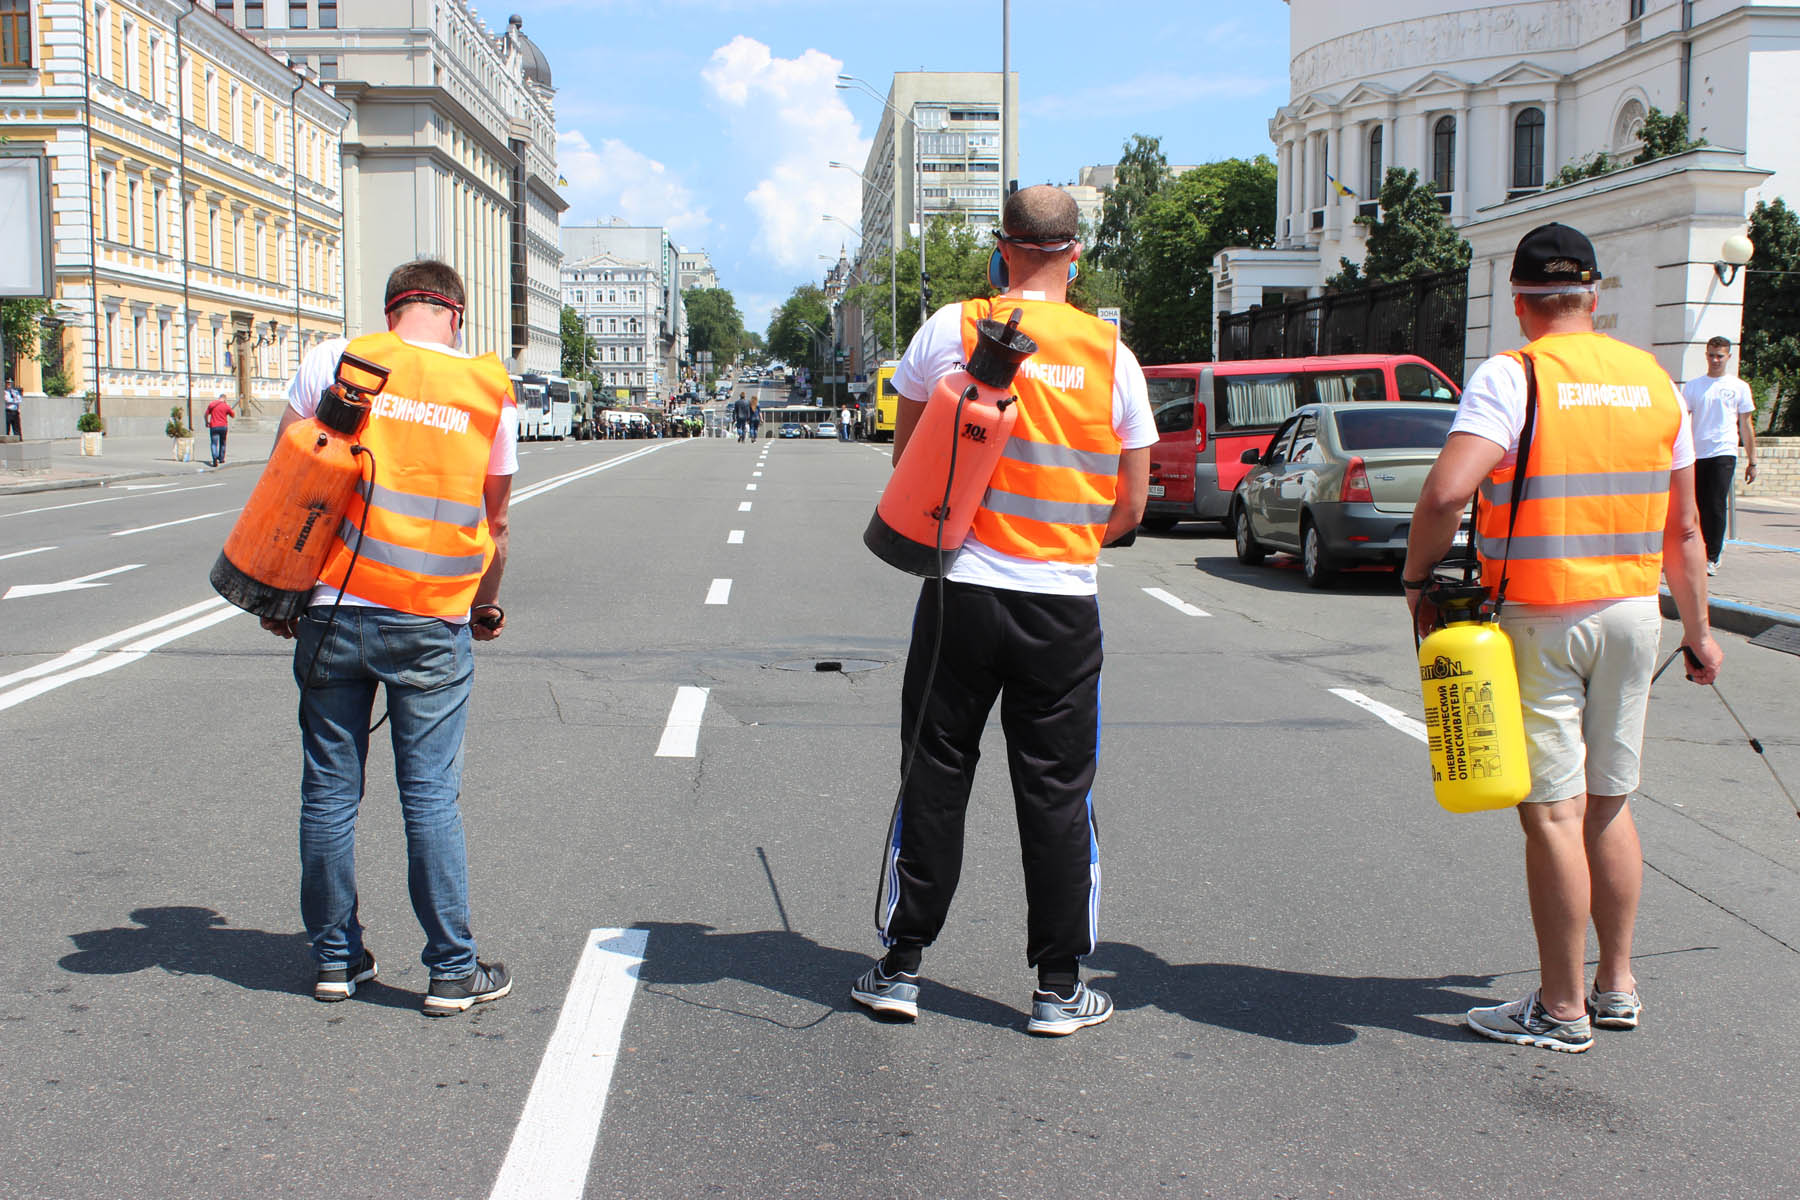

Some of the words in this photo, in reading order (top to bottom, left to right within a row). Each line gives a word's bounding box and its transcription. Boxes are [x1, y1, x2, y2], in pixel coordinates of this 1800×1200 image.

[370, 391, 470, 434] ДЕЗИНФЕКЦИЯ
[1557, 382, 1652, 412] ДЕЗИНФЕКЦИЯ
[1437, 684, 1457, 781] ПНЕВМАТИЧЕСКИЙ
[1449, 683, 1468, 780] ОПРЫСКИВАТЕЛЬ
